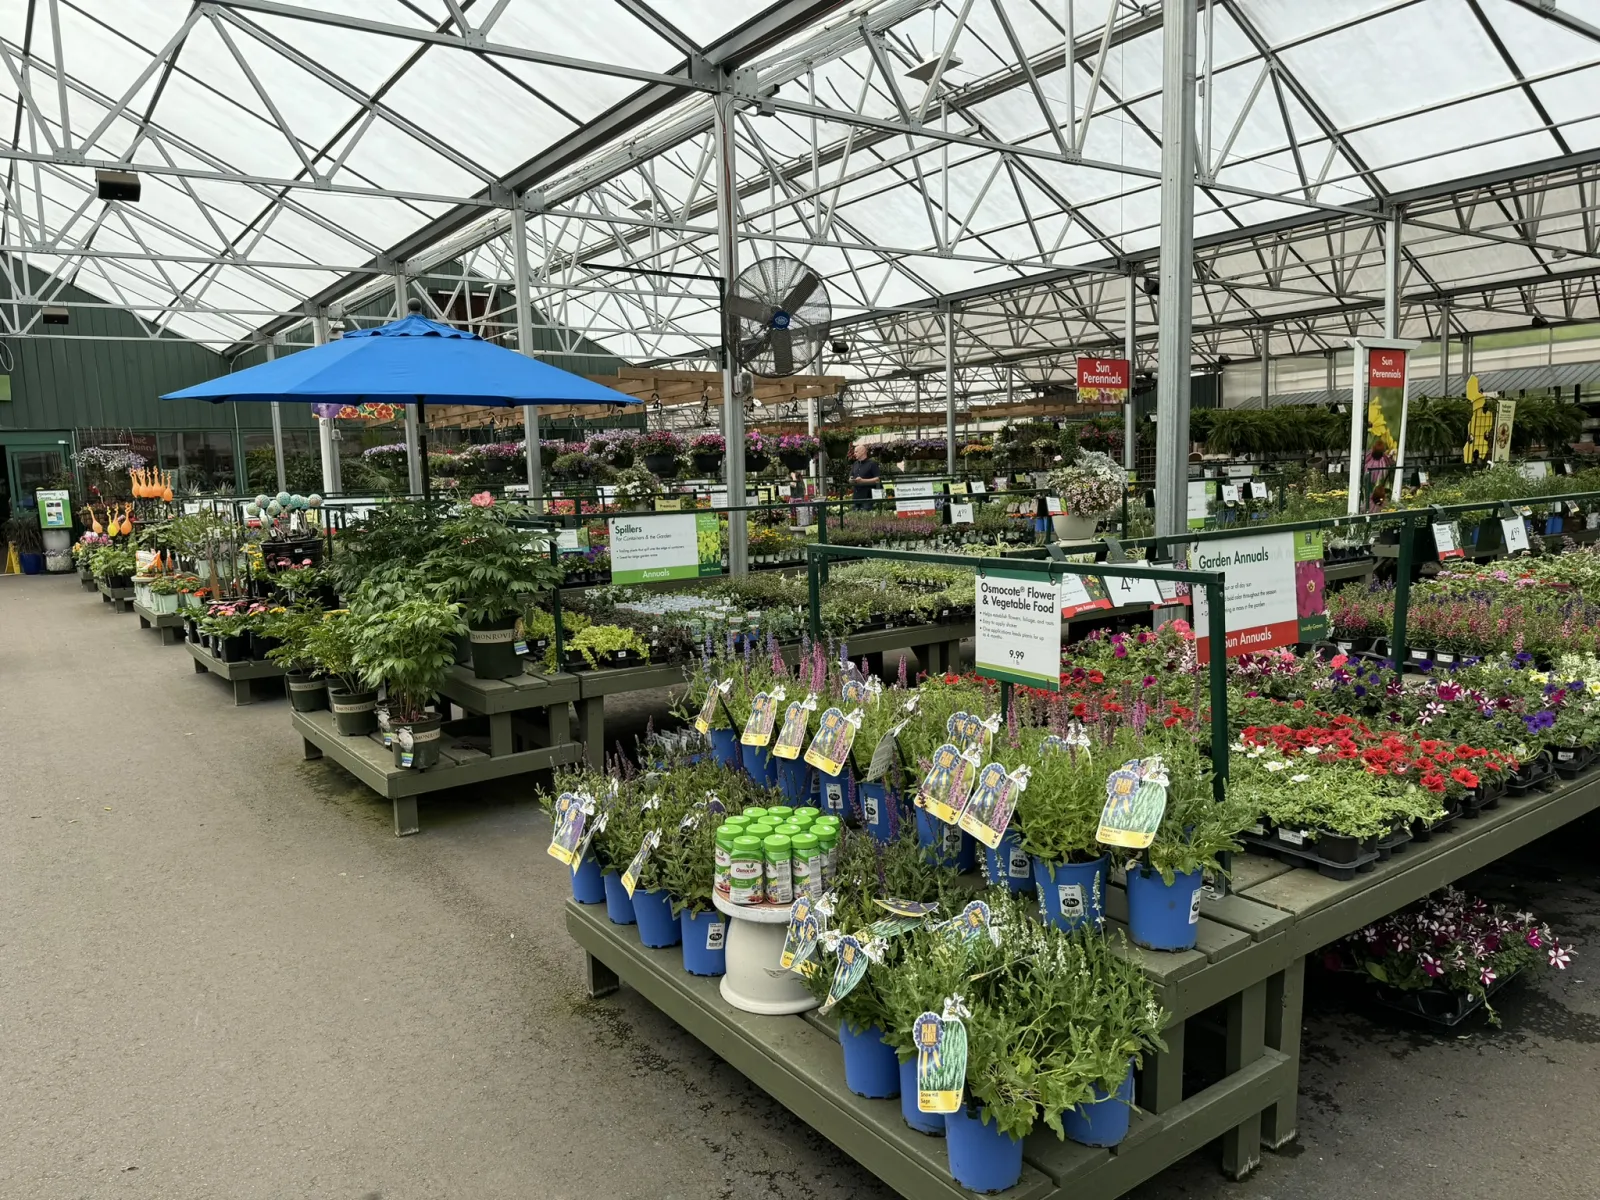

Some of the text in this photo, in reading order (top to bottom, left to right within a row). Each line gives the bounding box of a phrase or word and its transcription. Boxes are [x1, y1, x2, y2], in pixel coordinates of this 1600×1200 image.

[1381, 356, 1393, 366] Sun
[1095, 361, 1110, 373] Sun
[1083, 371, 1122, 384] Perennials
[1372, 368, 1402, 379] Perennials
[615, 524, 643, 536] Spillers
[1198, 546, 1269, 569] Garden Annuals
[642, 568, 670, 578] Annuals
[1027, 586, 1056, 600] Flower
[1242, 592, 1260, 600] throughout
[982, 595, 1054, 614] & Vegetable Food
[1254, 602, 1266, 610] garden
[475, 632, 511, 640] MONROVI
[1239, 627, 1272, 645] Annuals
[1008, 649, 1025, 660] 9.99
